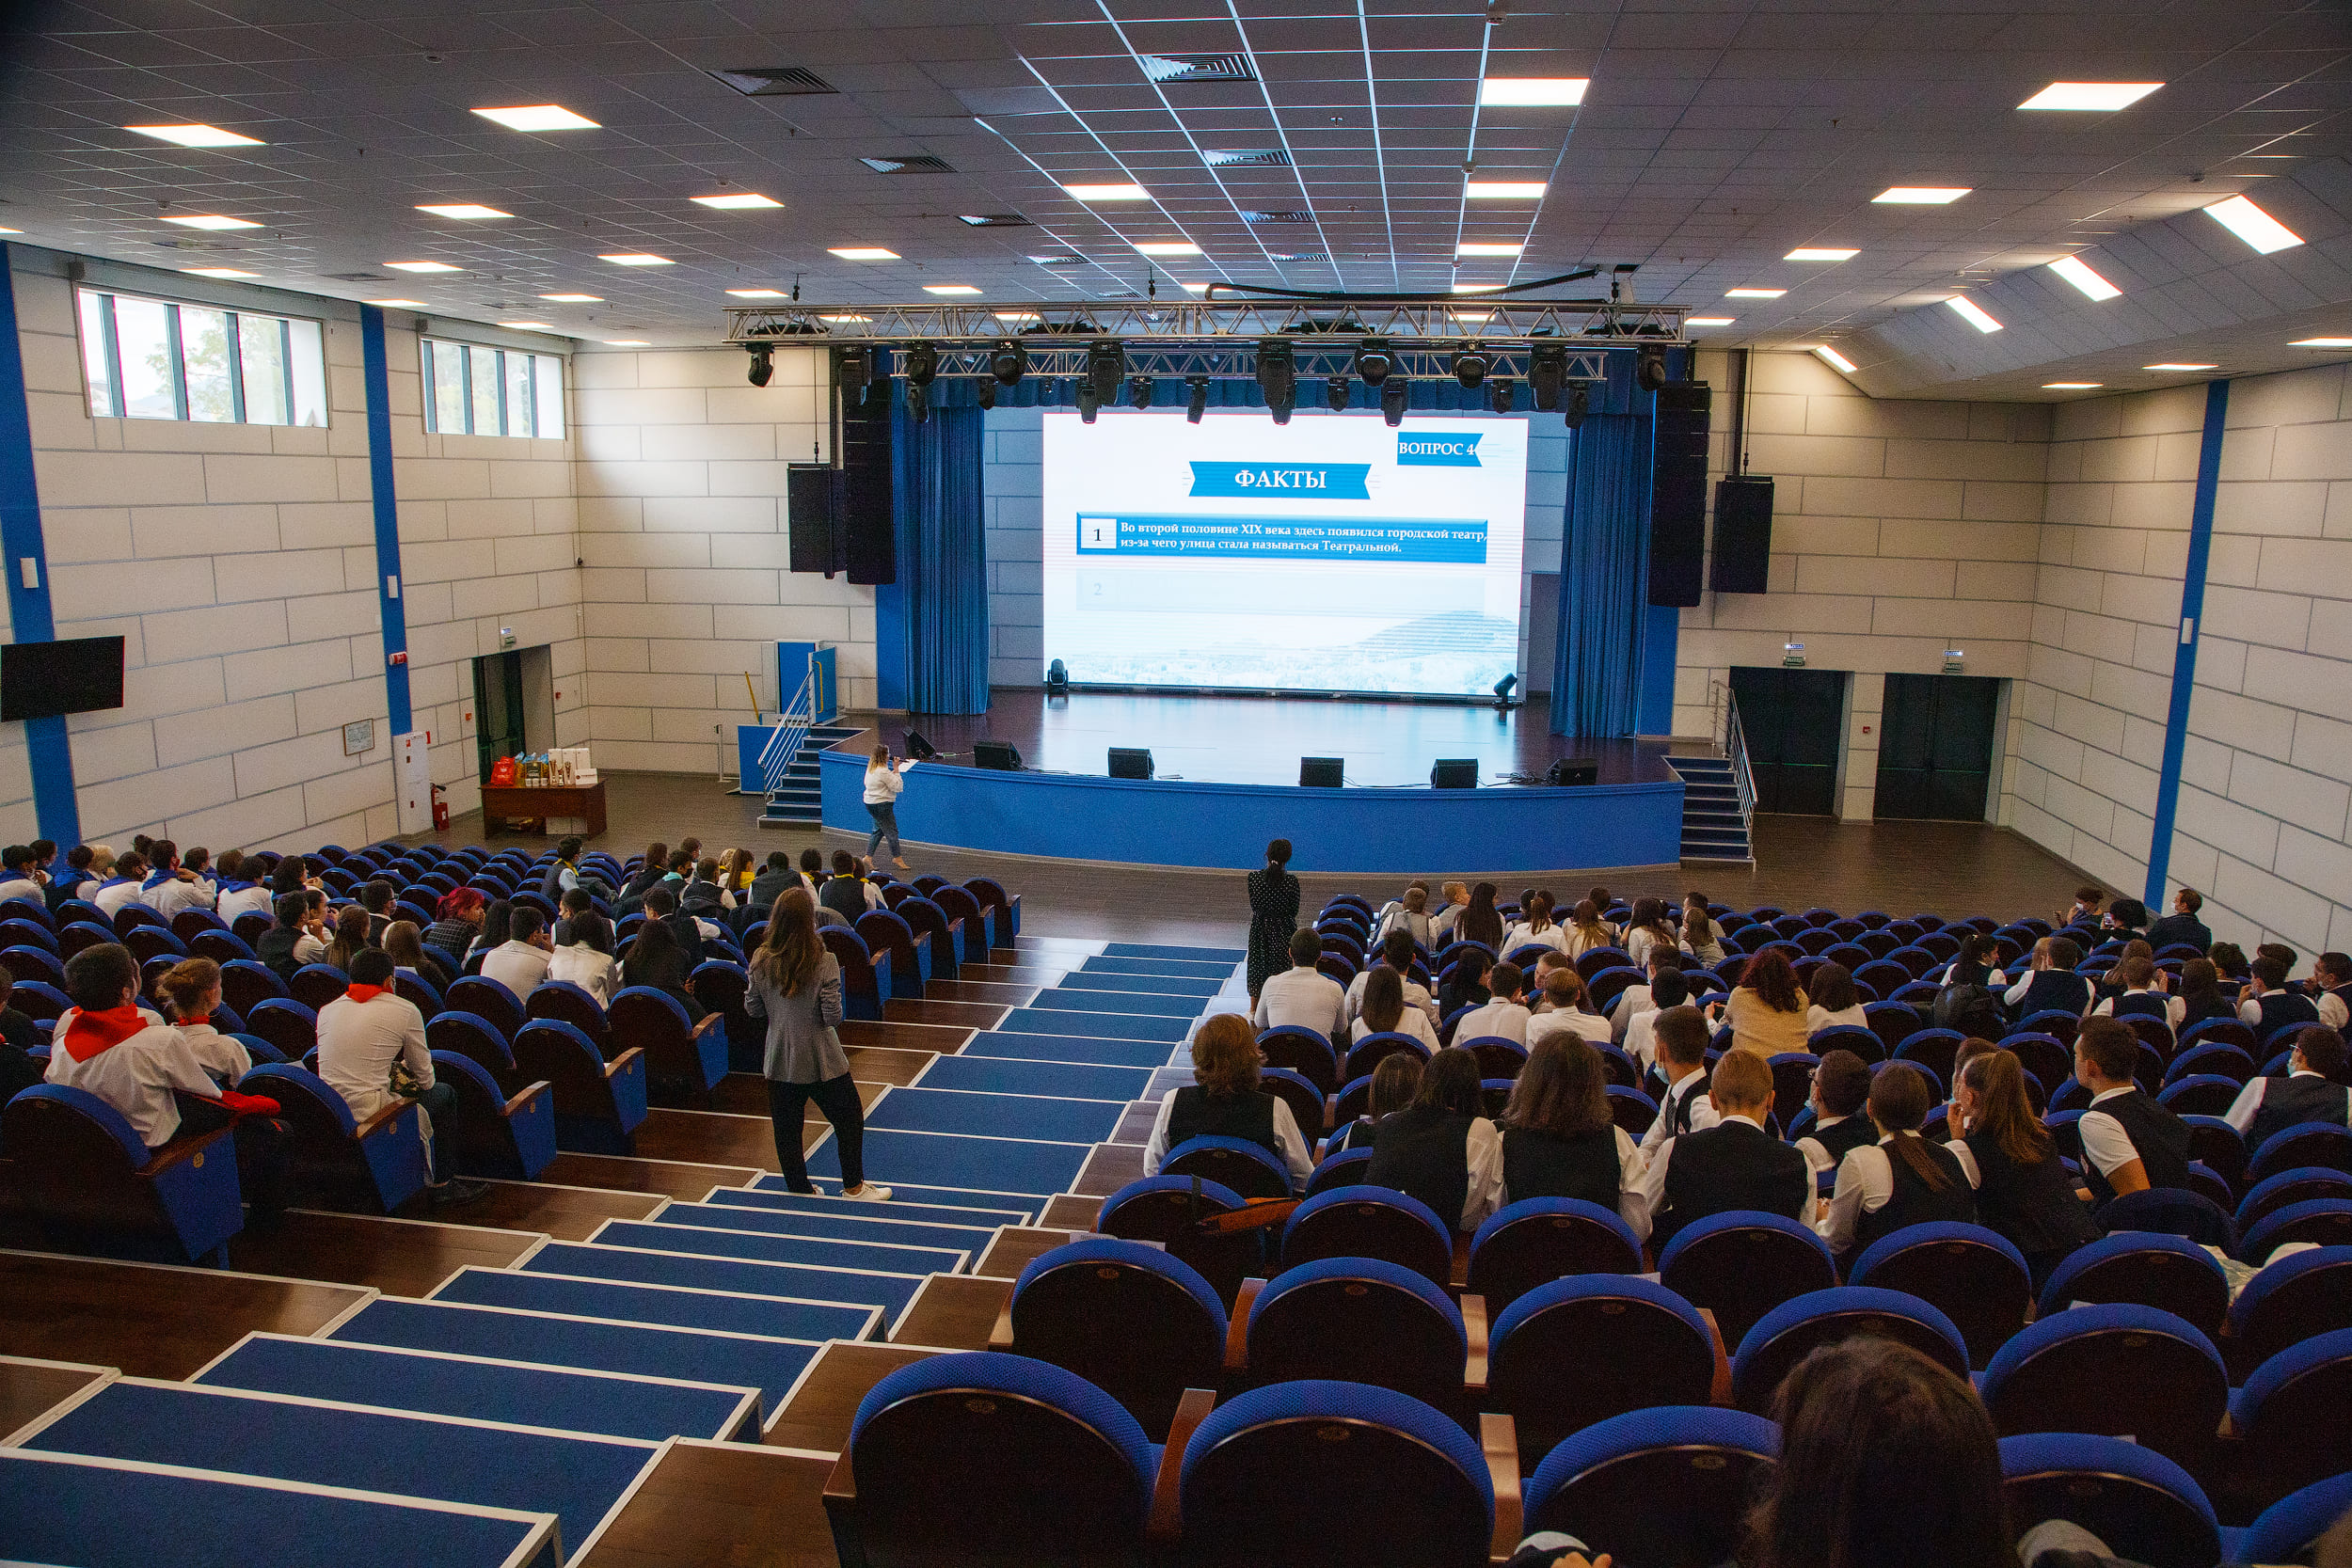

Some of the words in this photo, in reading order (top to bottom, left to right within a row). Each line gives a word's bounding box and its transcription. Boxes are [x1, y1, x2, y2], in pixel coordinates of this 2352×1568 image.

[1398, 441, 1464, 455] ВОПРОС
[1466, 443, 1475, 455] 4
[1234, 469, 1327, 488] ФАКТЫ
[1092, 528, 1102, 542] 1
[1120, 522, 1136, 533] Во
[1137, 523, 1179, 536] второй
[1182, 526, 1239, 535] половине
[1241, 524, 1263, 535] XIX
[1265, 526, 1292, 536] века
[1294, 527, 1325, 538] здесь
[1327, 528, 1384, 538] появился
[1387, 529, 1449, 541] городской
[1452, 531, 1487, 543] театр,
[1120, 538, 1149, 547] из-за
[1152, 539, 1177, 548] чего
[1180, 540, 1216, 551] улица
[1218, 541, 1249, 549] стала
[1252, 540, 1319, 550] называться
[1322, 540, 1402, 554] Театральной.
[1093, 582, 1103, 595] 2
